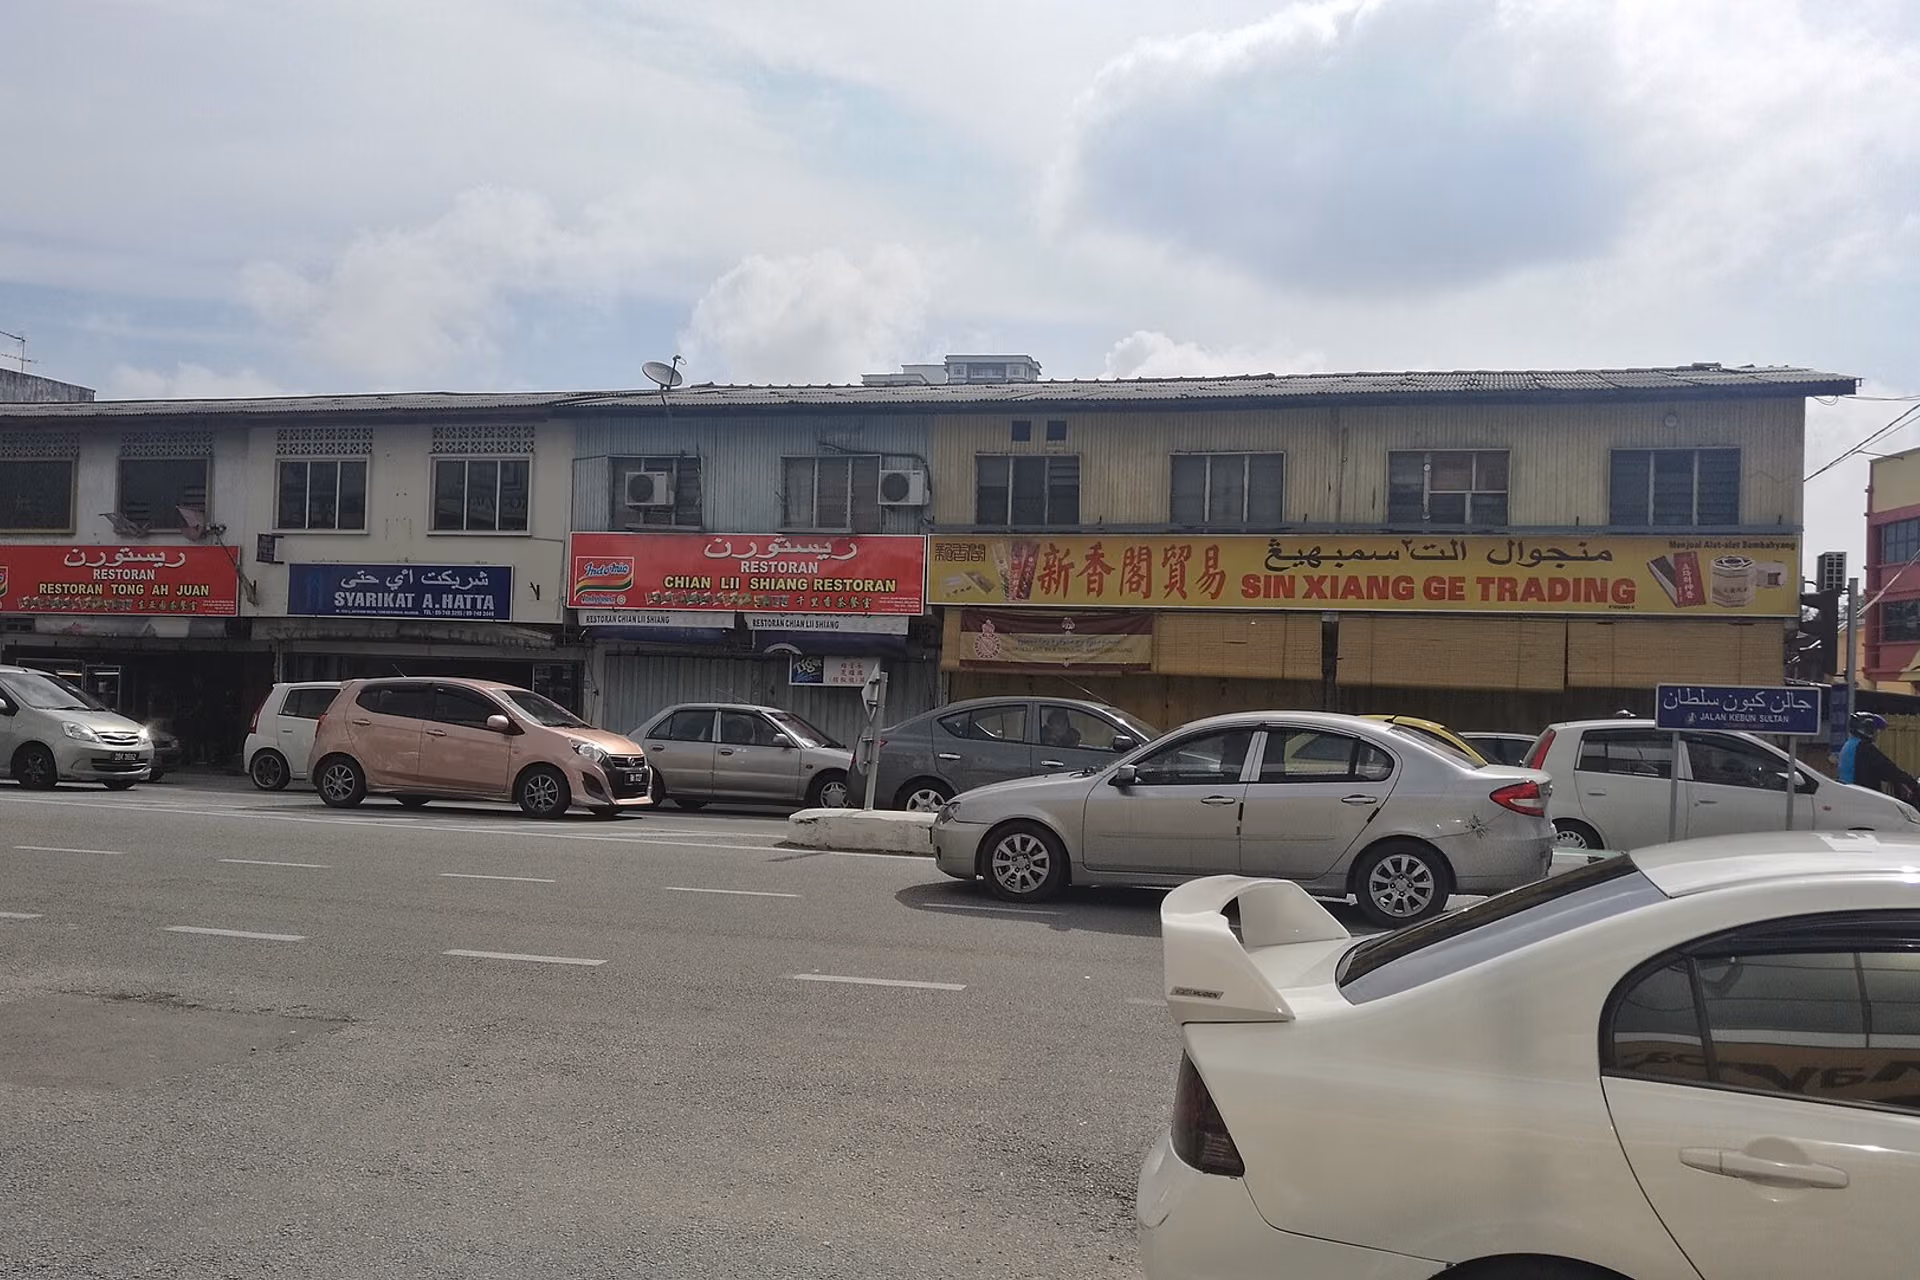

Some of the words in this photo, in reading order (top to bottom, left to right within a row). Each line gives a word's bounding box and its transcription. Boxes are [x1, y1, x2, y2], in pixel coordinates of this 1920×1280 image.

[64, 547, 186, 568] ريستورن
[704, 537, 857, 560] ريستورن
[93, 569, 155, 580] RESTORAN
[741, 561, 818, 575] RESTORAN
[1037, 541, 1226, 600] 新香閣貿易
[40, 583, 103, 594] RESTORAN
[111, 584, 144, 595] TONG
[152, 585, 168, 595] AH
[176, 585, 209, 596] JUAN
[664, 576, 711, 590] CHIAN
[721, 577, 740, 590] LII
[750, 578, 808, 592] SHIANG
[813, 579, 896, 593] RESTORAN
[1241, 574, 1296, 599] SIN
[1302, 575, 1415, 600] XIANG
[1423, 576, 1466, 601] GE
[1476, 576, 1636, 604] TRADING
[334, 591, 415, 608] SYARIKAT
[423, 594, 495, 610] A.HATTA
[586, 615, 617, 624] RESTORAN
[618, 615, 637, 624] CHIAN
[646, 615, 670, 625] SHIANG
[753, 619, 784, 628] RESTORAN
[785, 620, 804, 628] CHIAN
[815, 621, 839, 629] SHIANG
[1663, 688, 1719, 710] سلطان
[1723, 691, 1766, 712] كبون
[1769, 691, 1812, 713] جالن
[1700, 712, 1727, 722] JALAN
[1729, 714, 1756, 722] KEBUN
[1759, 715, 1789, 723] SULTAN
